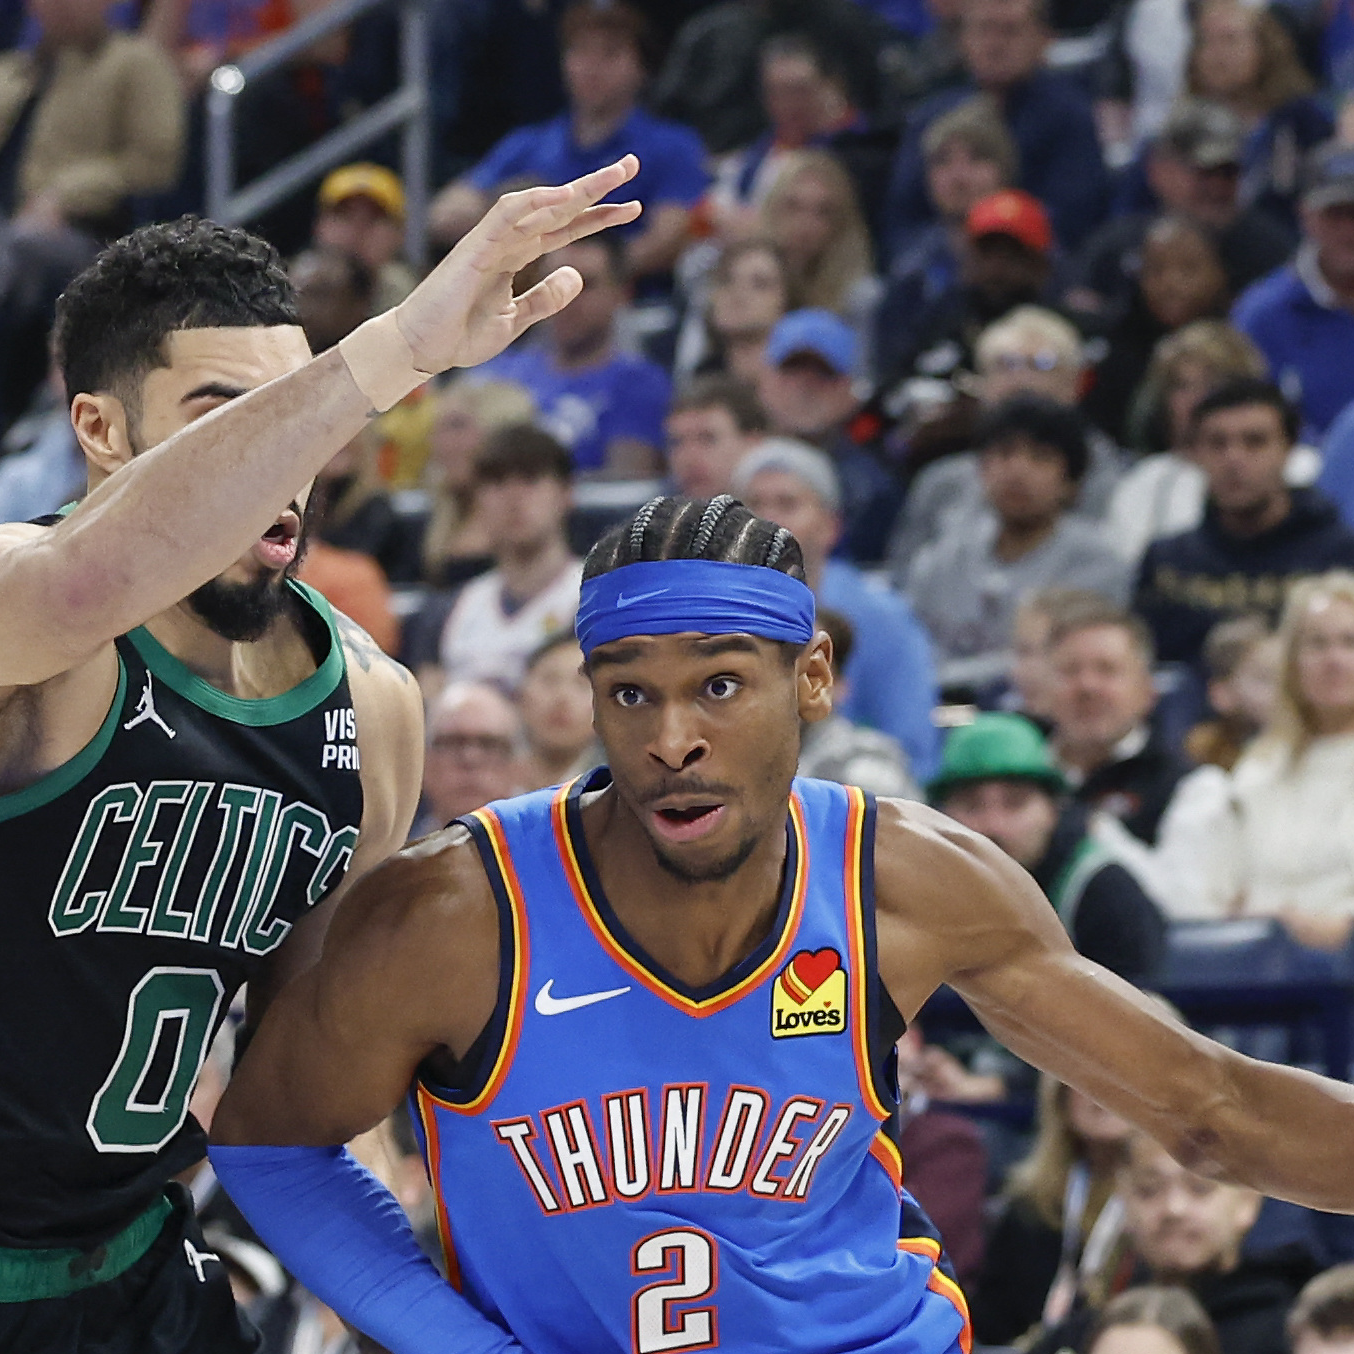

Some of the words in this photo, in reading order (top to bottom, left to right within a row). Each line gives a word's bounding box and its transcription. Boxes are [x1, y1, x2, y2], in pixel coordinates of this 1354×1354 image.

[321, 744, 361, 770] PRI
[324, 708, 356, 741] VIS
[85, 965, 226, 1154] 0
[490, 1082, 853, 1217] THUNDER
